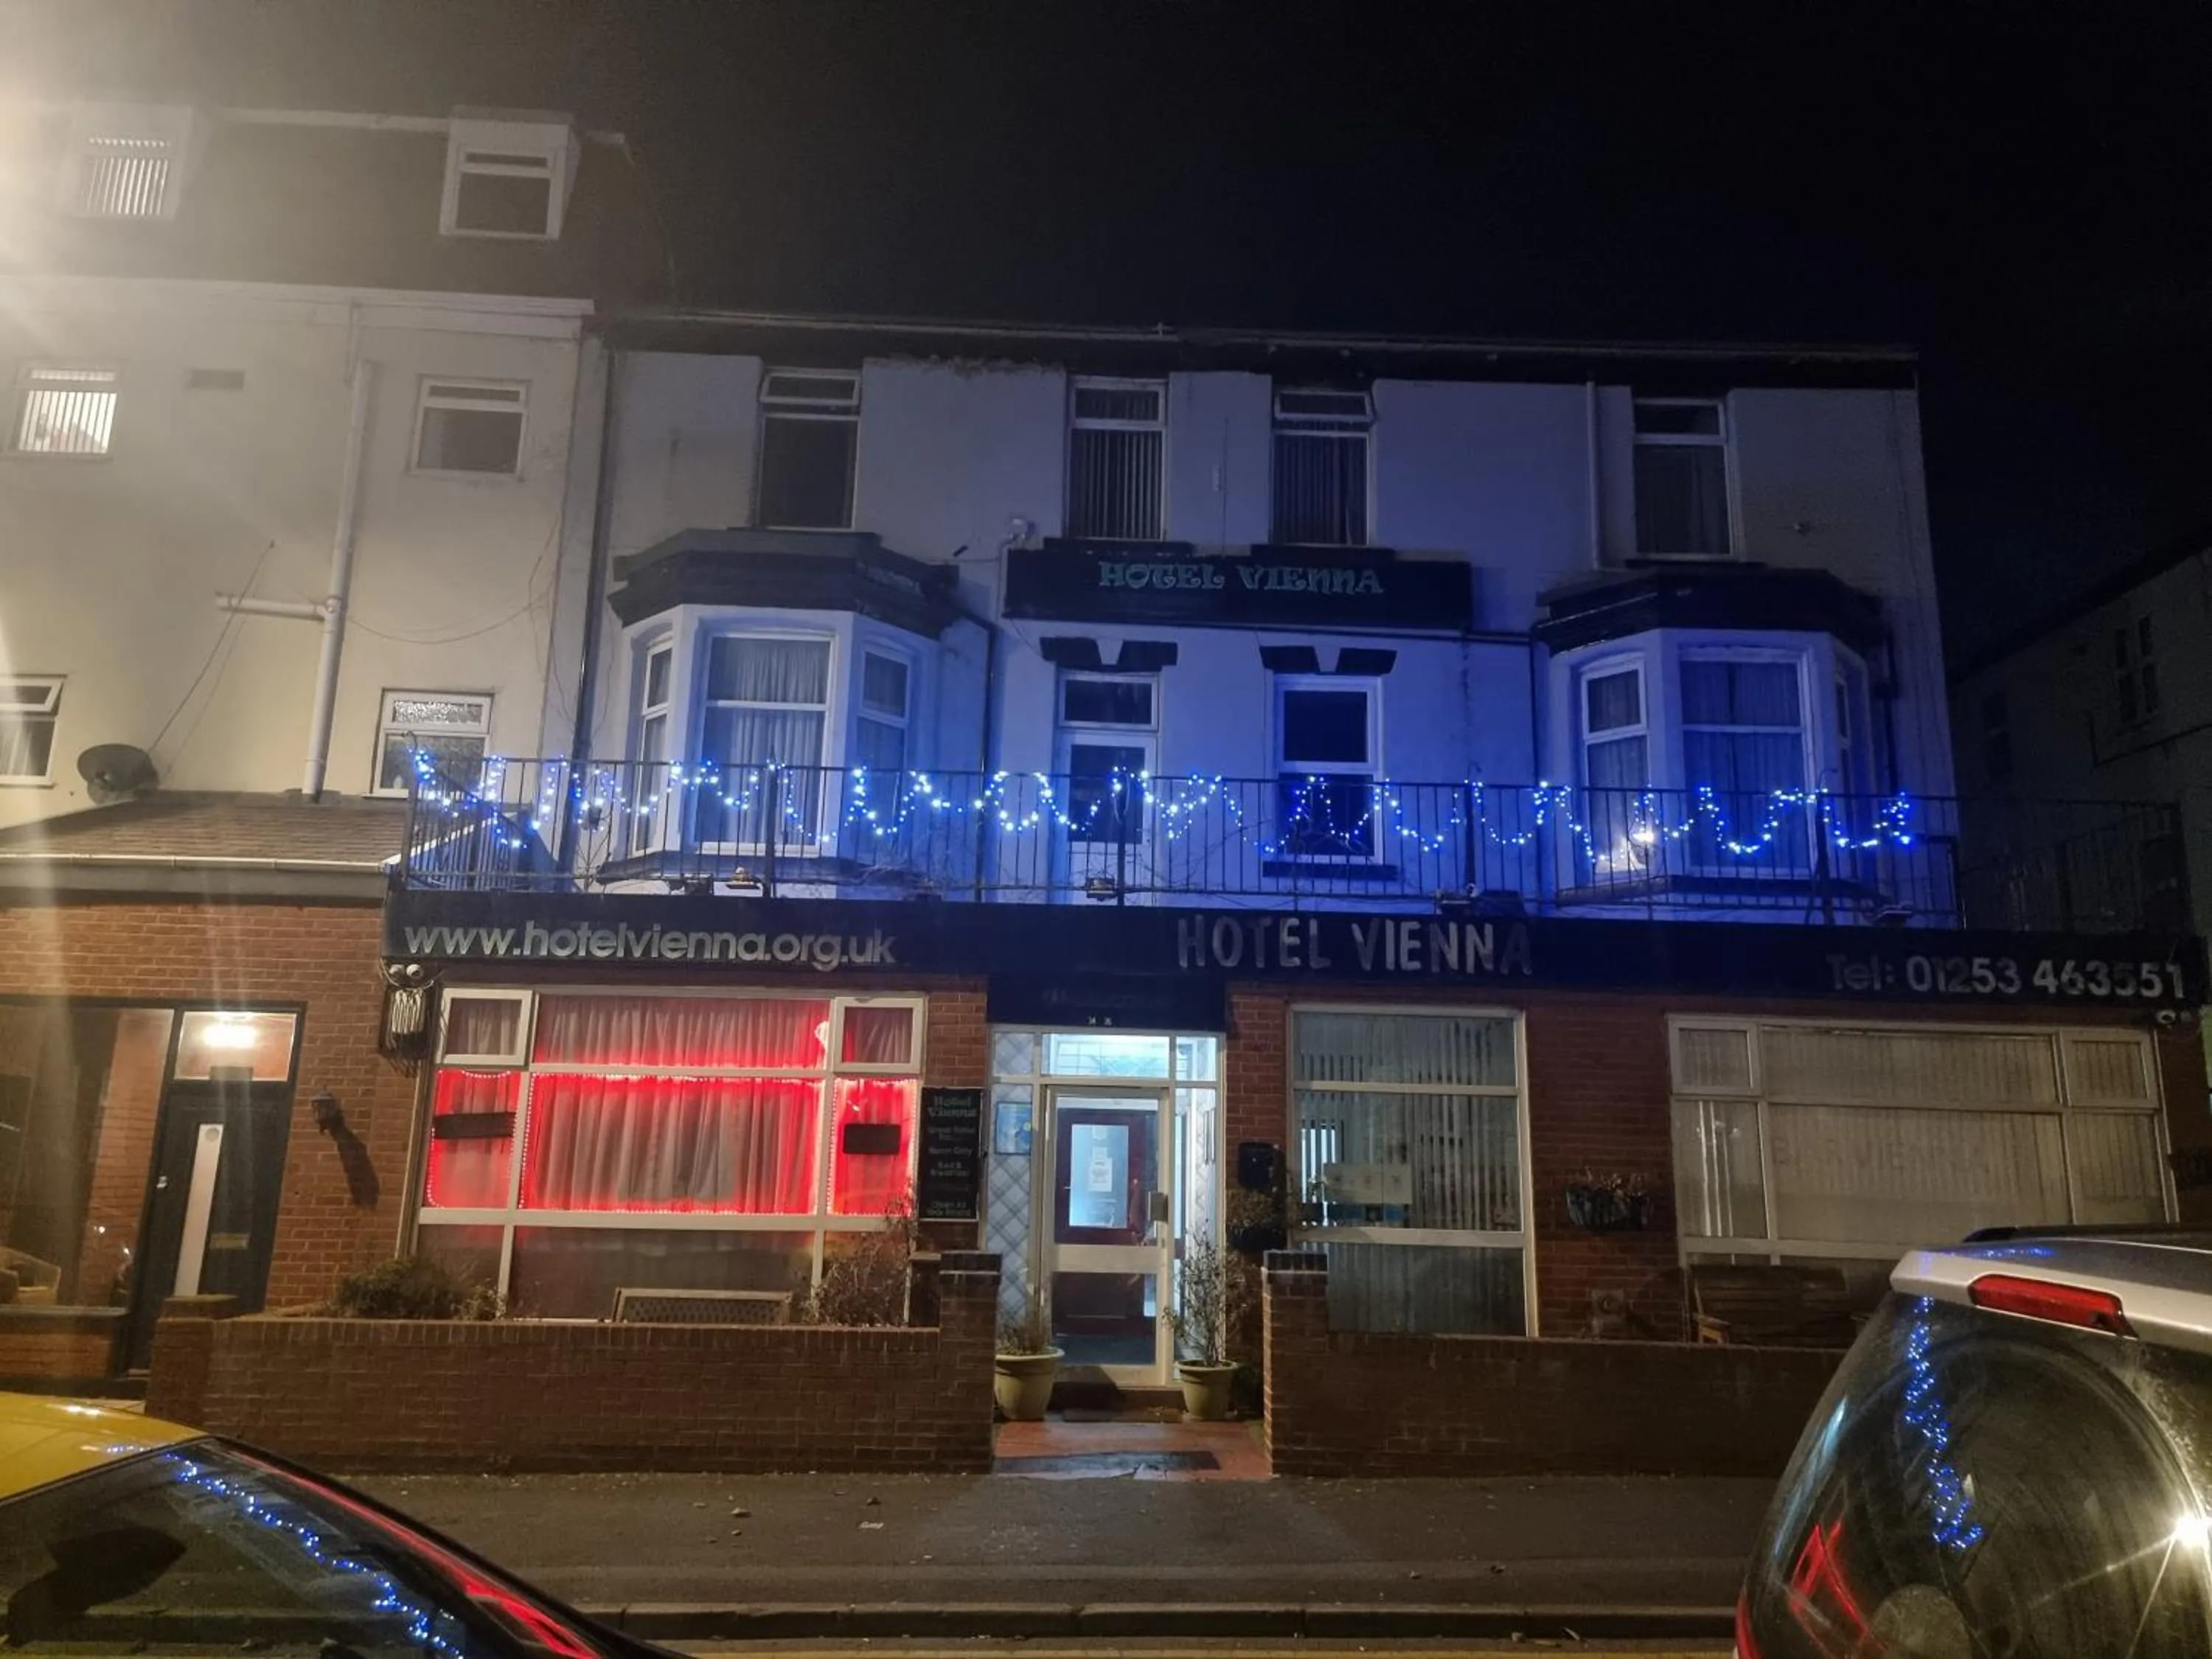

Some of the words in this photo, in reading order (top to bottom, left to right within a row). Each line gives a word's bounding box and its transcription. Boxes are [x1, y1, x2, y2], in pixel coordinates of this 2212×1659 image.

[1099, 562, 1225, 589] HOTEL
[405, 920, 897, 972] www.hotelvienna.org.uk
[1178, 914, 1332, 969] HOTEL
[1351, 919, 1534, 974] VIENNA
[1826, 954, 1894, 990] Tel:
[1906, 956, 2021, 995] 01253
[2033, 959, 2185, 999] 463551
